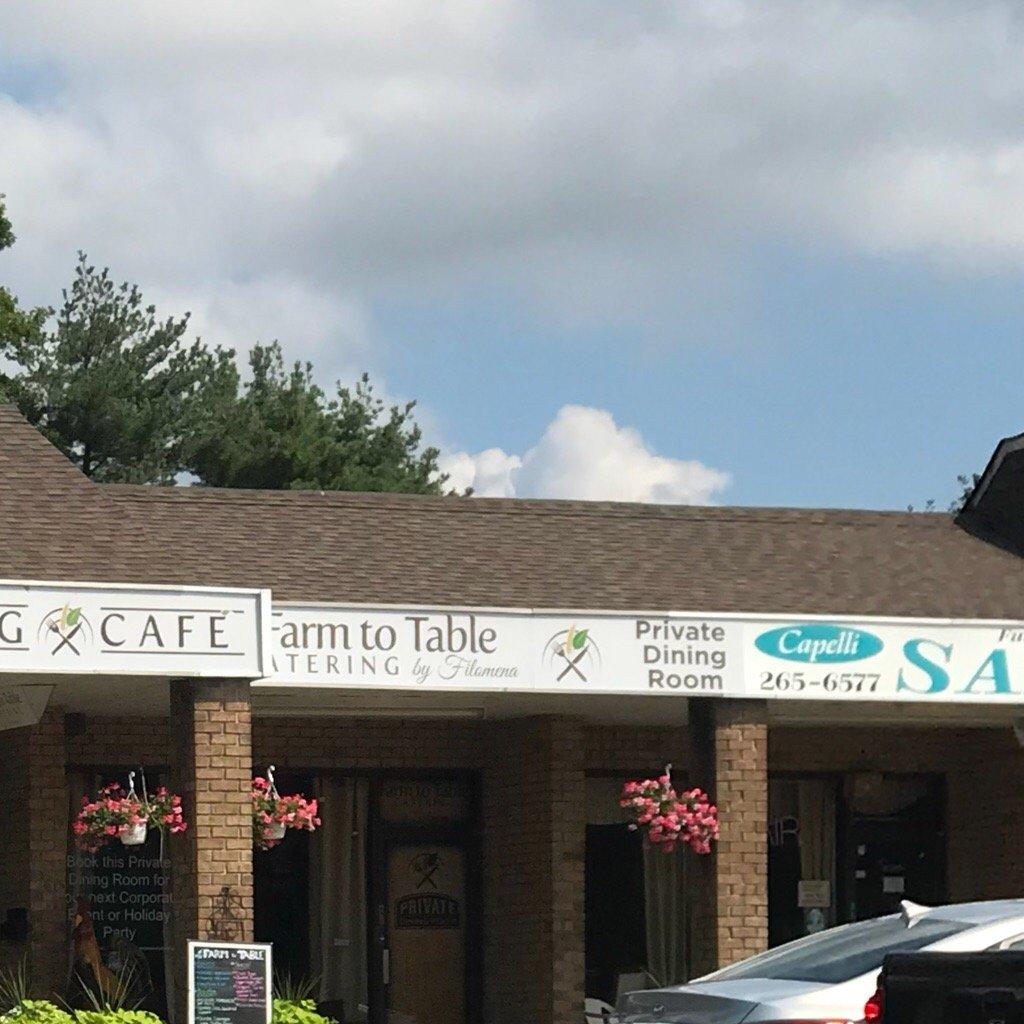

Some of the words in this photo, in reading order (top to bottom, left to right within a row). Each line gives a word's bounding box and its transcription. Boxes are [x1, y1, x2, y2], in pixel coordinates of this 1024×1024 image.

[361, 614, 397, 651] to
[405, 615, 497, 654] Table
[636, 620, 726, 642] Private
[778, 629, 861, 662] Capelli
[643, 645, 726, 669] Dining
[412, 657, 431, 685] by
[648, 669, 723, 690] Room
[760, 671, 882, 693] 265-6577
[67, 855, 98, 868] Book
[103, 855, 124, 868] this
[128, 855, 172, 869] Private
[112, 873, 150, 886] Room
[154, 873, 171, 886] for
[107, 911, 121, 922] or
[124, 908, 172, 925] Holiday
[102, 925, 137, 942] Party
